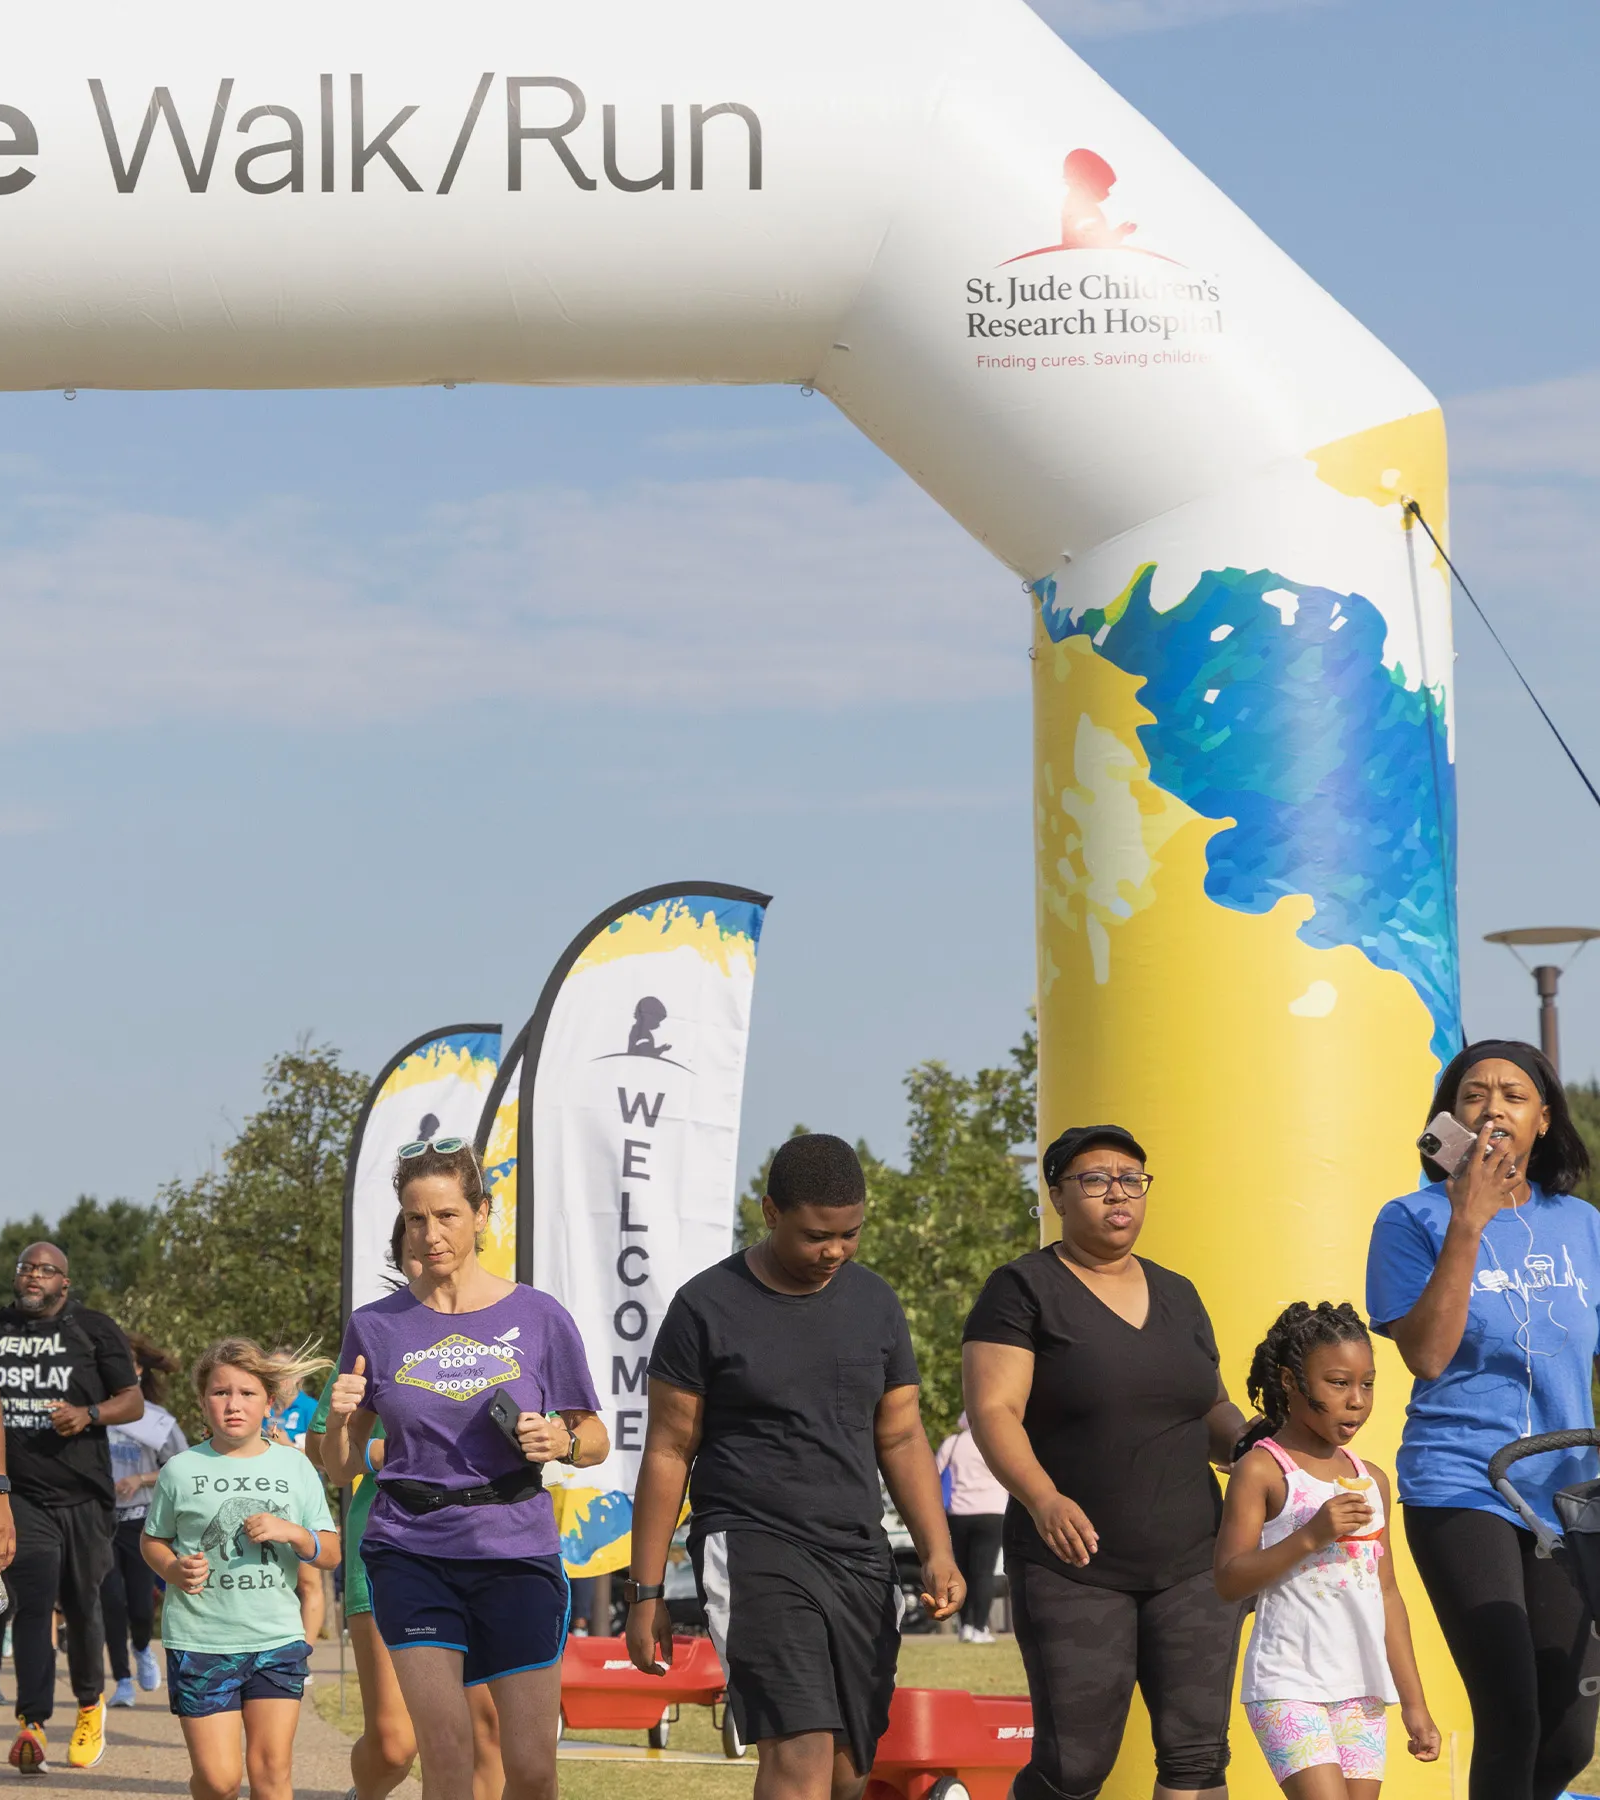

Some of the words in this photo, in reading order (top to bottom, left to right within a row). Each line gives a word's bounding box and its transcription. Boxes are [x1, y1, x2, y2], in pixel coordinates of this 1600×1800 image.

[87, 72, 763, 195] Walk/Run
[966, 277, 1003, 304] St.
[1006, 275, 1073, 310] Jude
[966, 309, 1097, 338] Research
[976, 355, 1037, 371] Finding
[1041, 353, 1090, 368] cures.
[1093, 351, 1148, 368] Saving
[611, 1086, 666, 1452] WELCOME
[406, 1347, 511, 1362] DRAGONFLY
[442, 1356, 474, 1368] TRI
[437, 1379, 486, 1391] 2022
[10, 1397, 30, 1412] THE
[191, 1475, 290, 1495] Foxes
